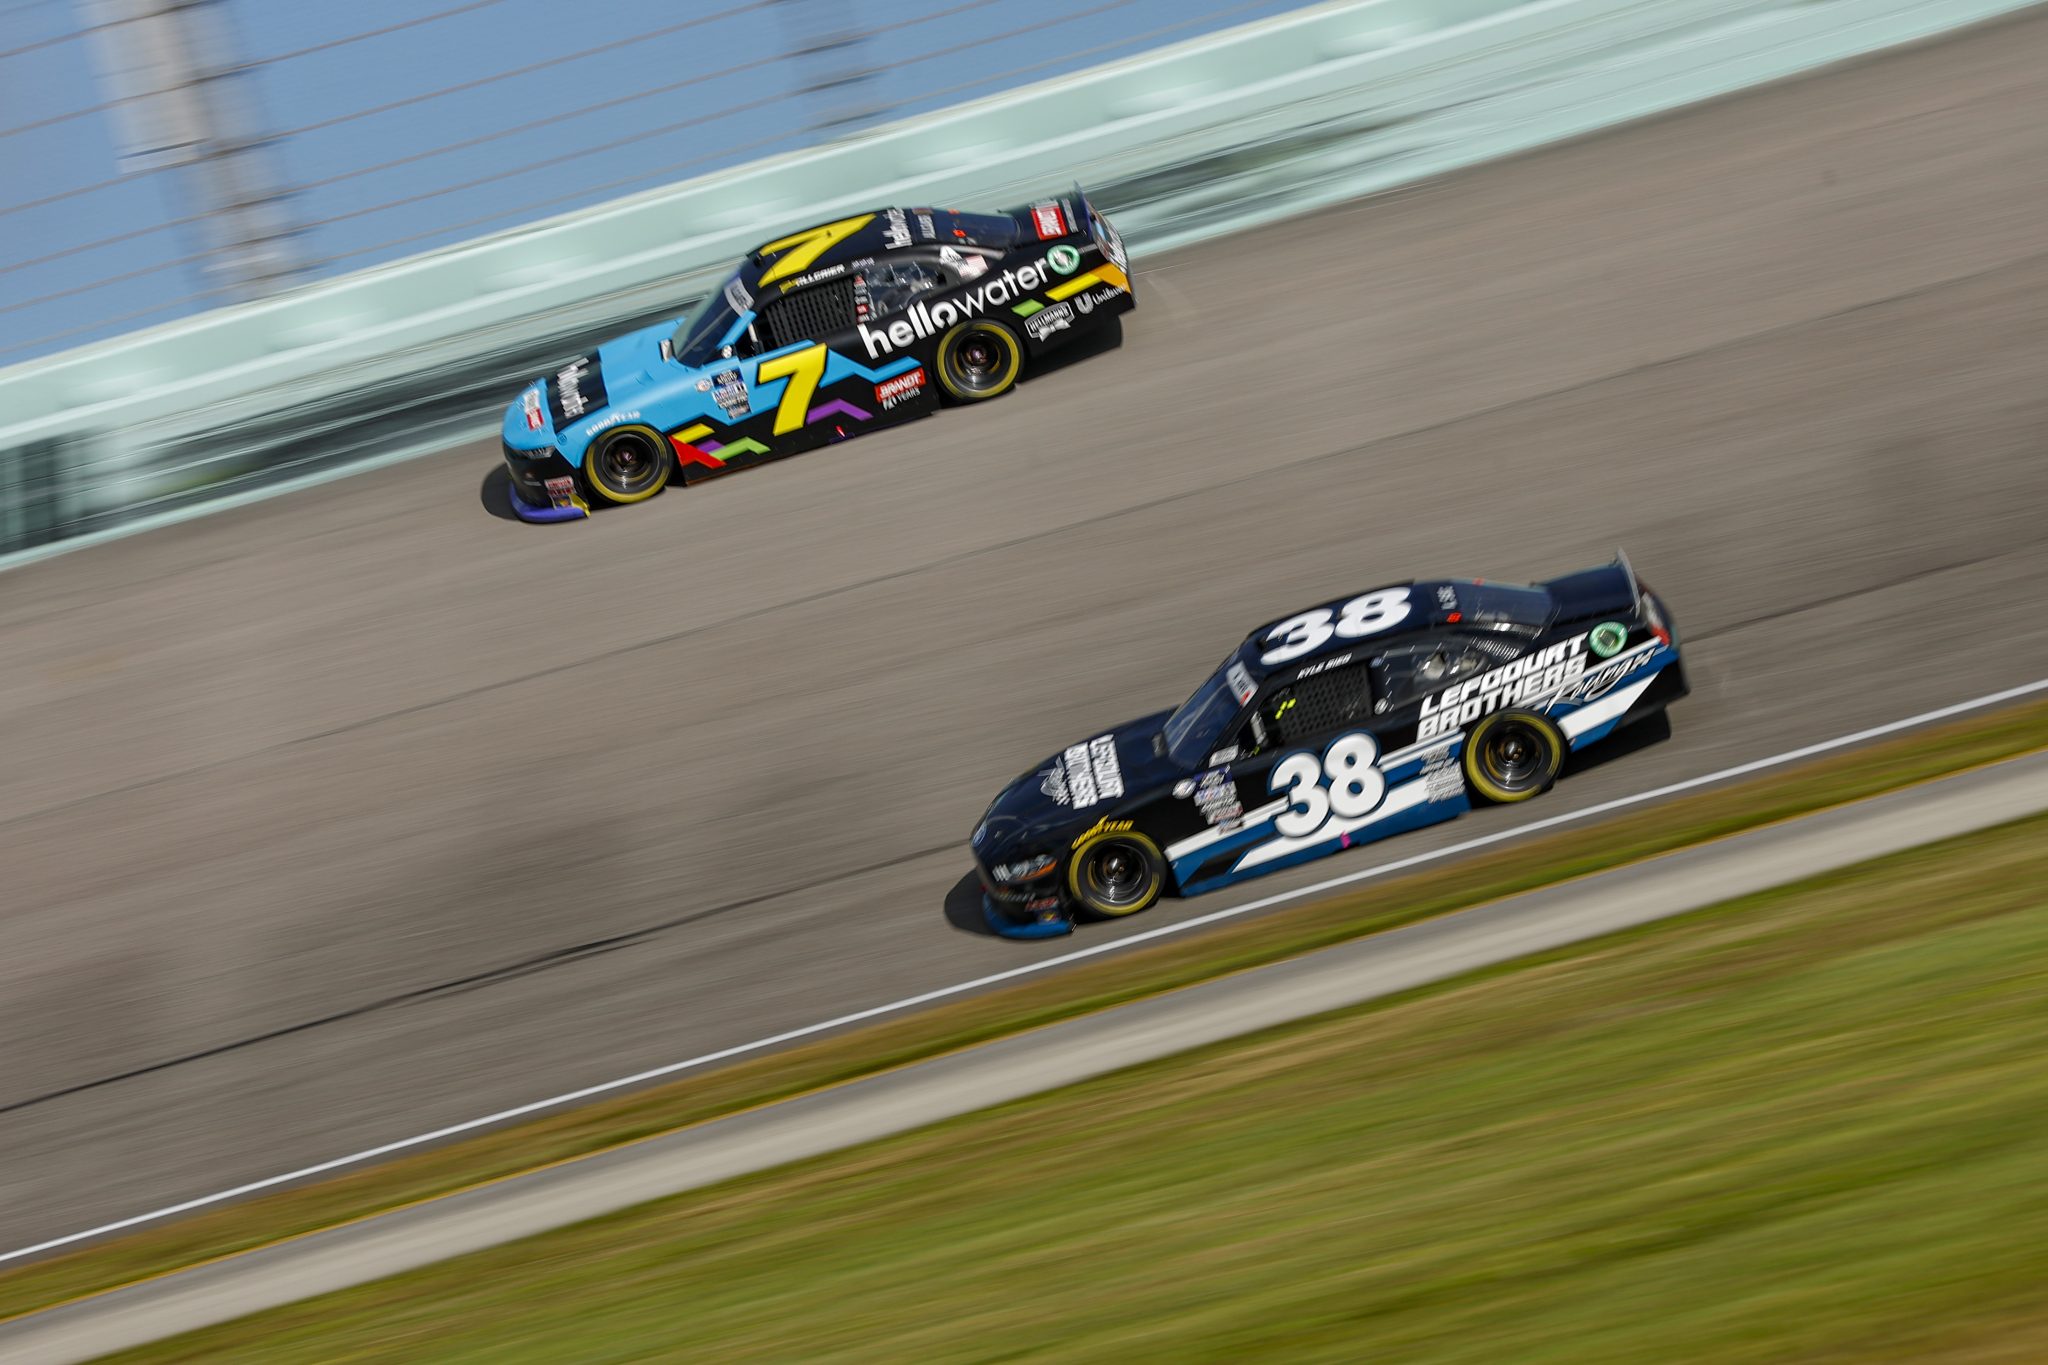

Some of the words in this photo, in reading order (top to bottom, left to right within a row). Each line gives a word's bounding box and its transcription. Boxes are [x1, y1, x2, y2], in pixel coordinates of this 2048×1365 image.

[758, 213, 877, 288] 7
[857, 257, 1047, 360] hellowater
[758, 343, 828, 437] 7
[879, 371, 922, 399] BRANDT
[896, 386, 921, 403] YEARS
[1260, 587, 1412, 666] 38
[1416, 651, 1588, 743] BROTHERS
[1418, 631, 1589, 721] LEFCOURT
[1270, 733, 1385, 838] 38
[1071, 814, 1134, 851] GOODYEAR
